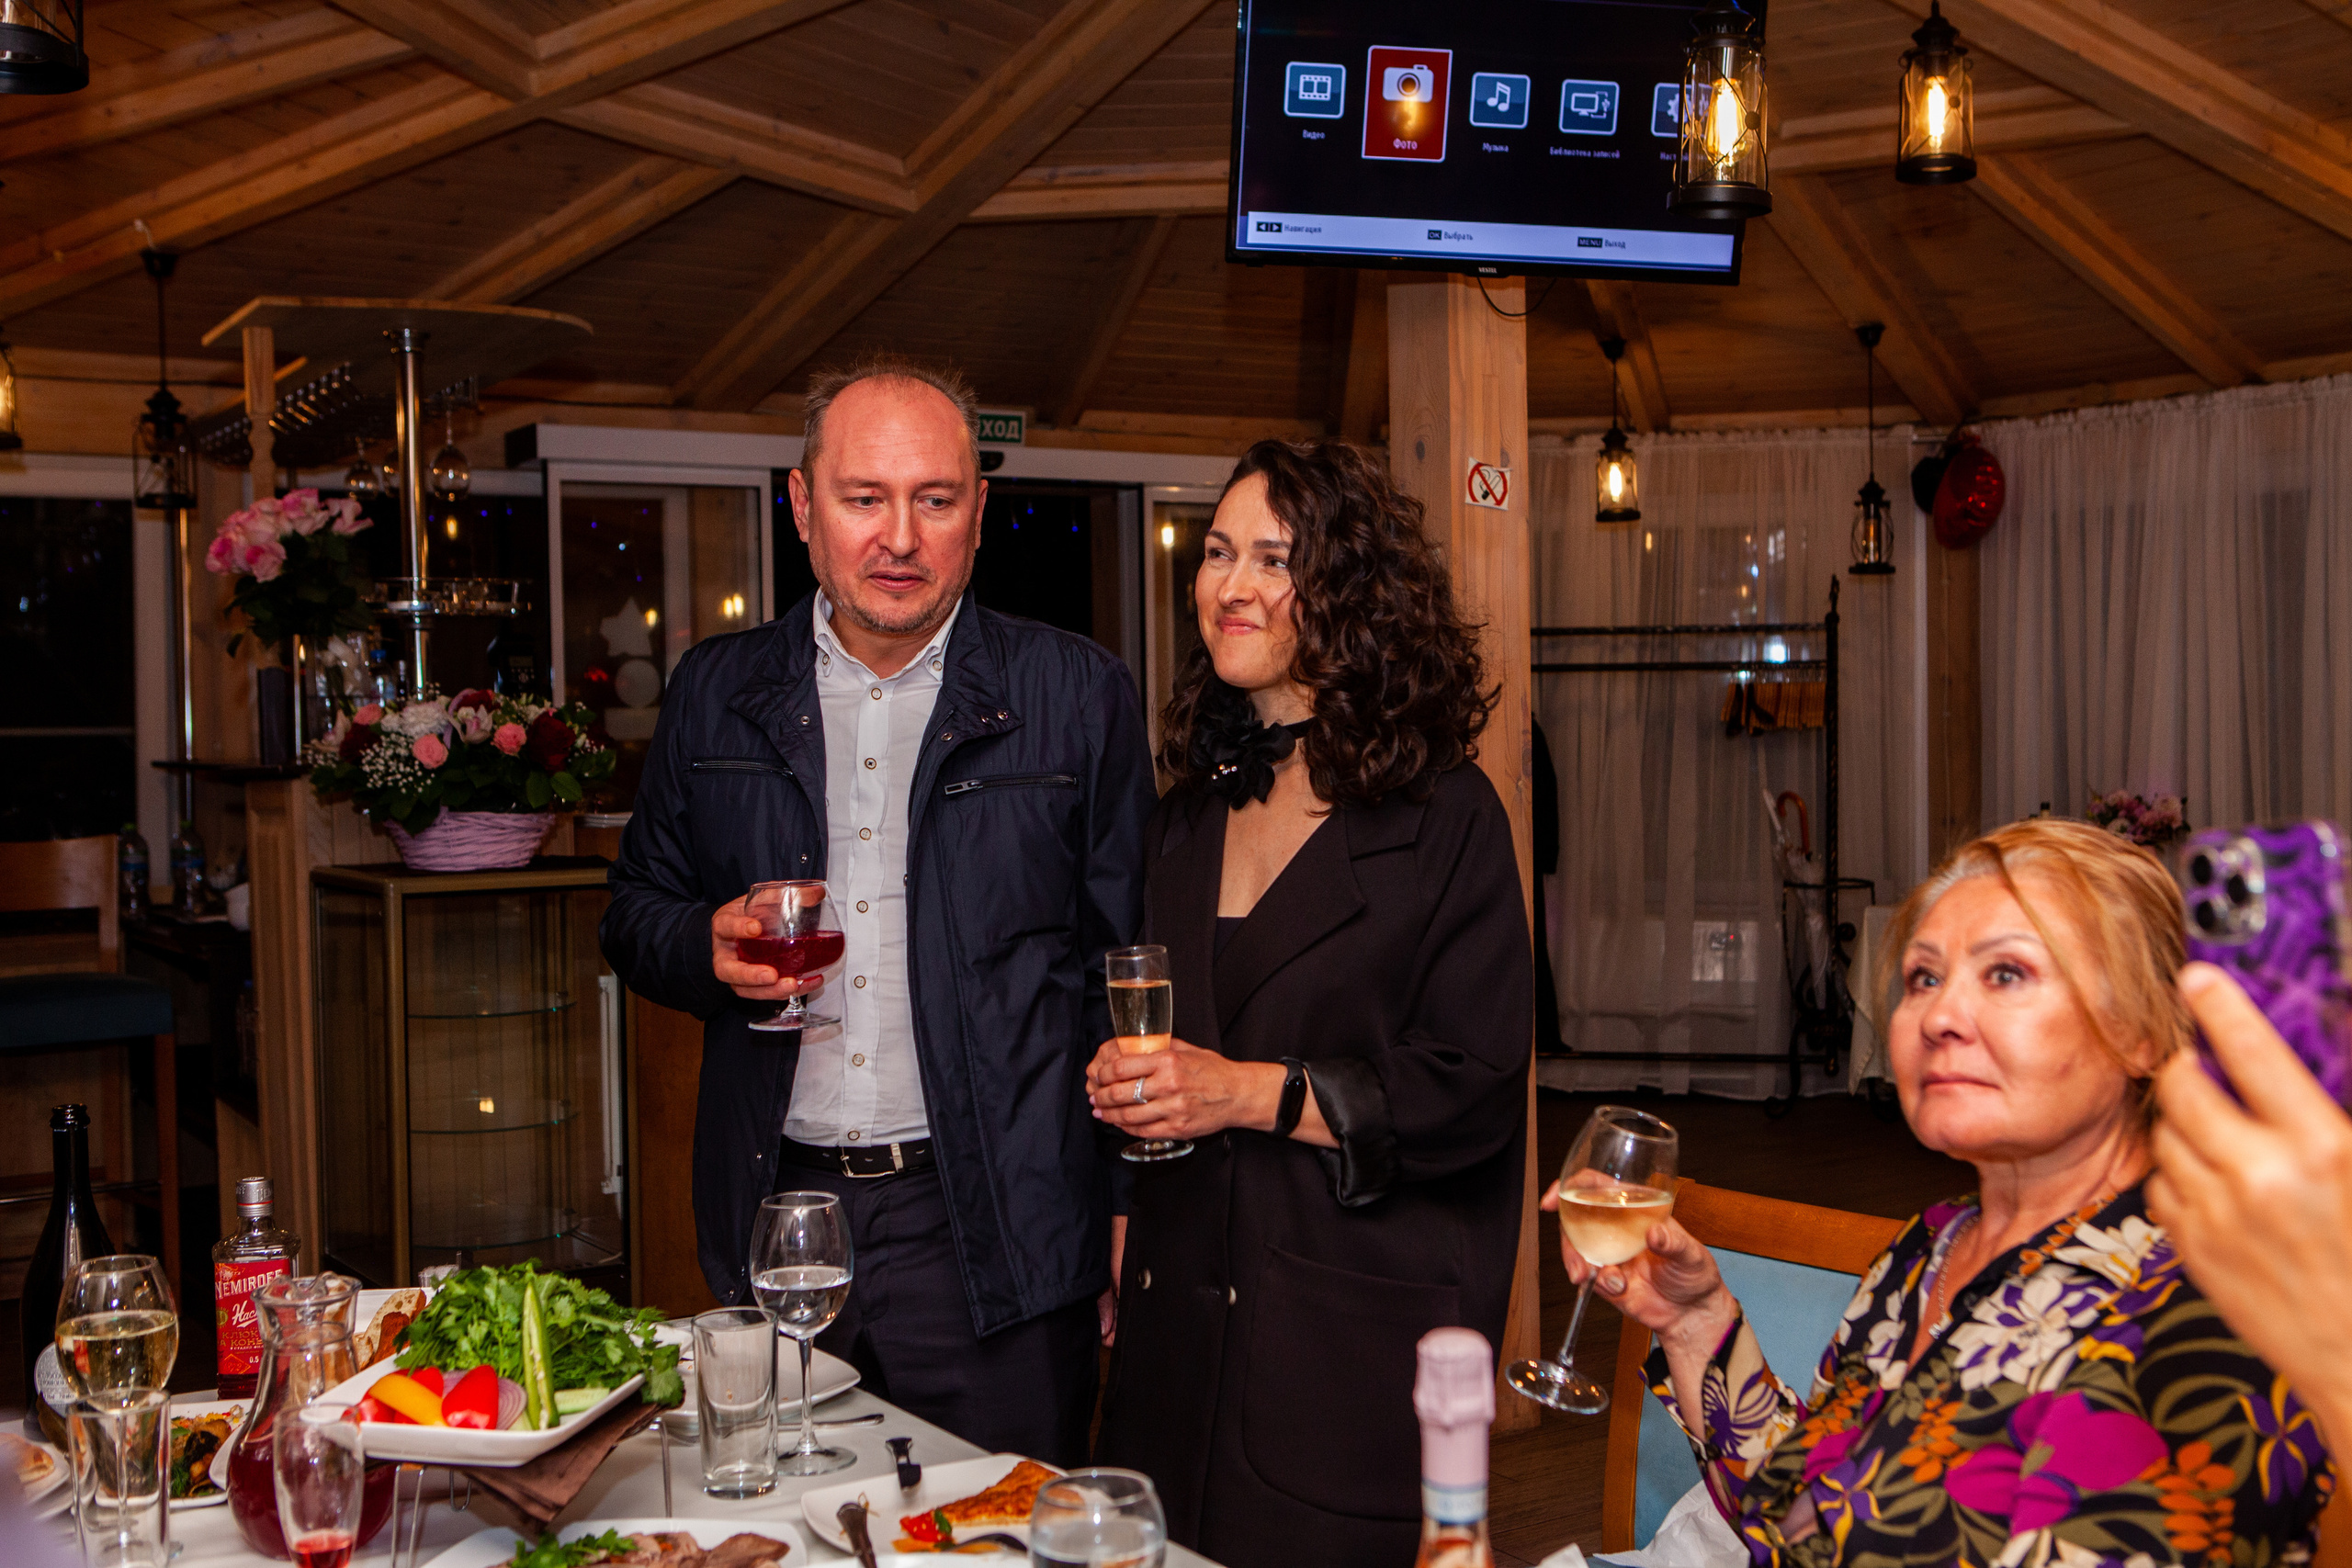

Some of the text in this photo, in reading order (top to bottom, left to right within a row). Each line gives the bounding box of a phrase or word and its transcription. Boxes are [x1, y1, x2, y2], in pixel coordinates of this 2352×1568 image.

[1302, 130, 1326, 140] Видео
[1393, 138, 1419, 151] Фото
[1482, 142, 1510, 153] Музыка
[1284, 223, 1322, 234] Навигация
[1429, 231, 1441, 239] OK
[1443, 231, 1474, 242] Выбрать
[1578, 238, 1601, 247] MENU
[1604, 239, 1626, 249] Выход
[978, 419, 1020, 440] ХОД
[222, 1330, 258, 1339] КЛЮК
[231, 1337, 264, 1347] КОНЬ
[249, 1355, 260, 1364] 0.5
